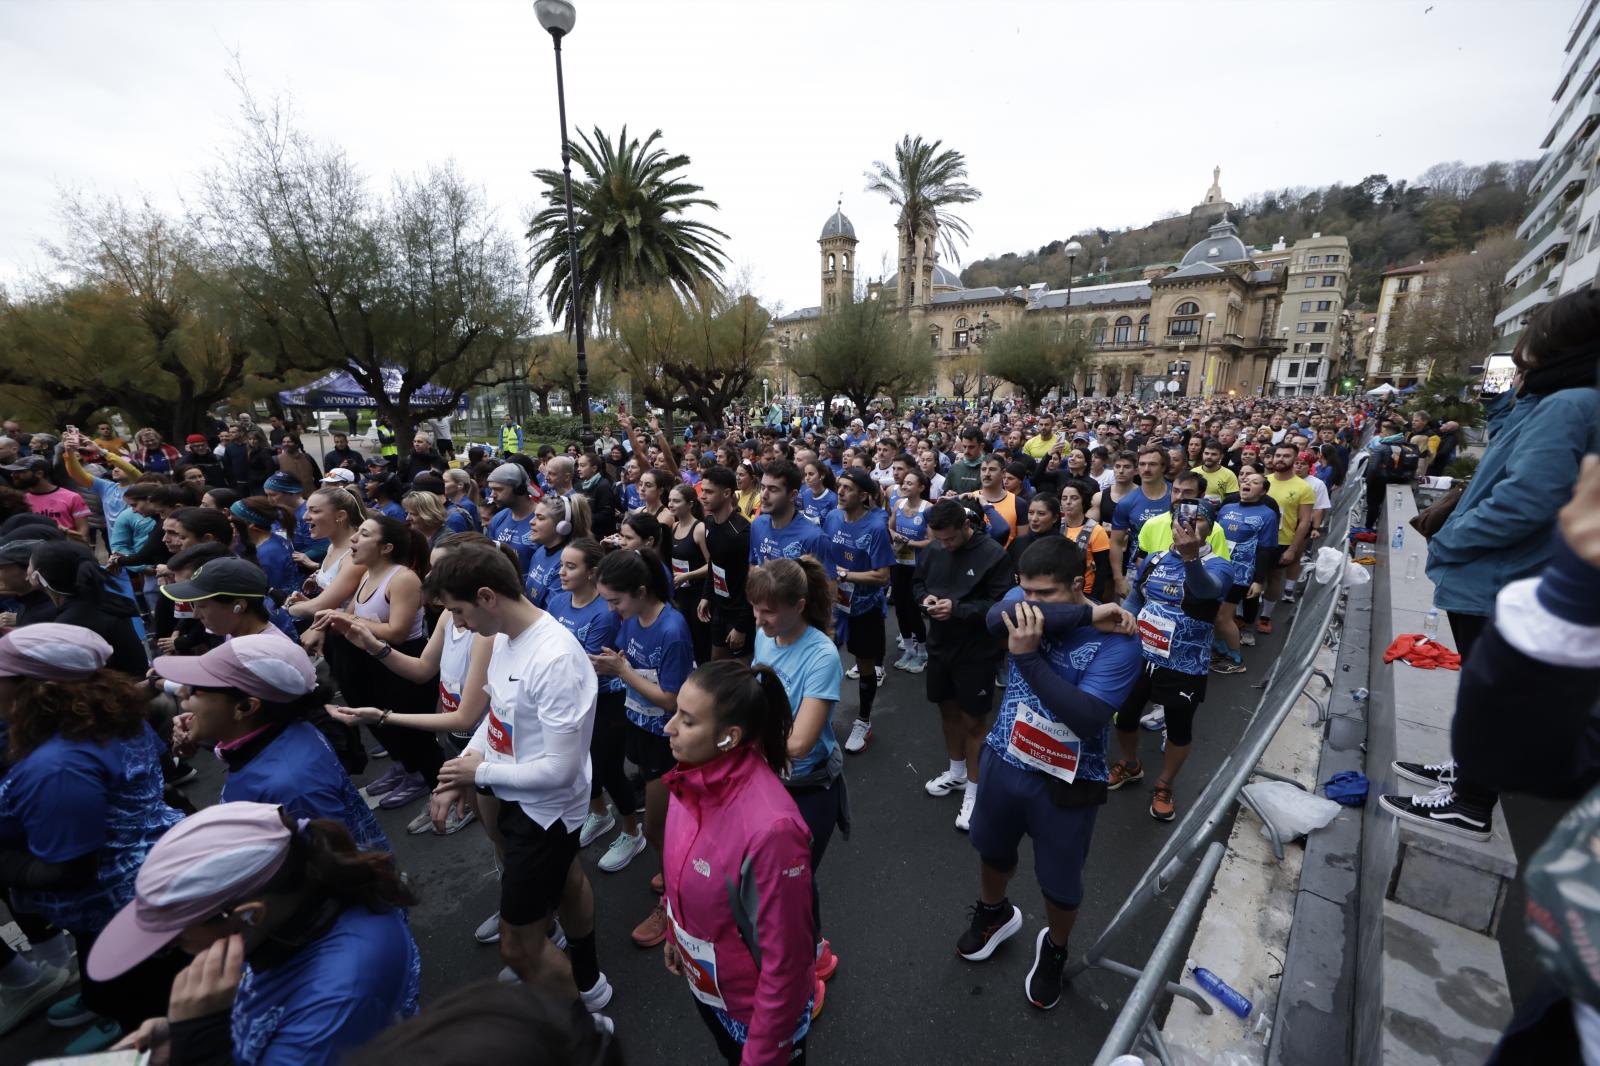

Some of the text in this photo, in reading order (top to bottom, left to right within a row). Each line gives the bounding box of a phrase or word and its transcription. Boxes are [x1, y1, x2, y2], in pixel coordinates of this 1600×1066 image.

[1035, 721, 1069, 737] ZURICH
[1018, 733, 1046, 752] YOSHIRO
[1046, 748, 1077, 761] RAMSES
[1029, 748, 1052, 764] 11563
